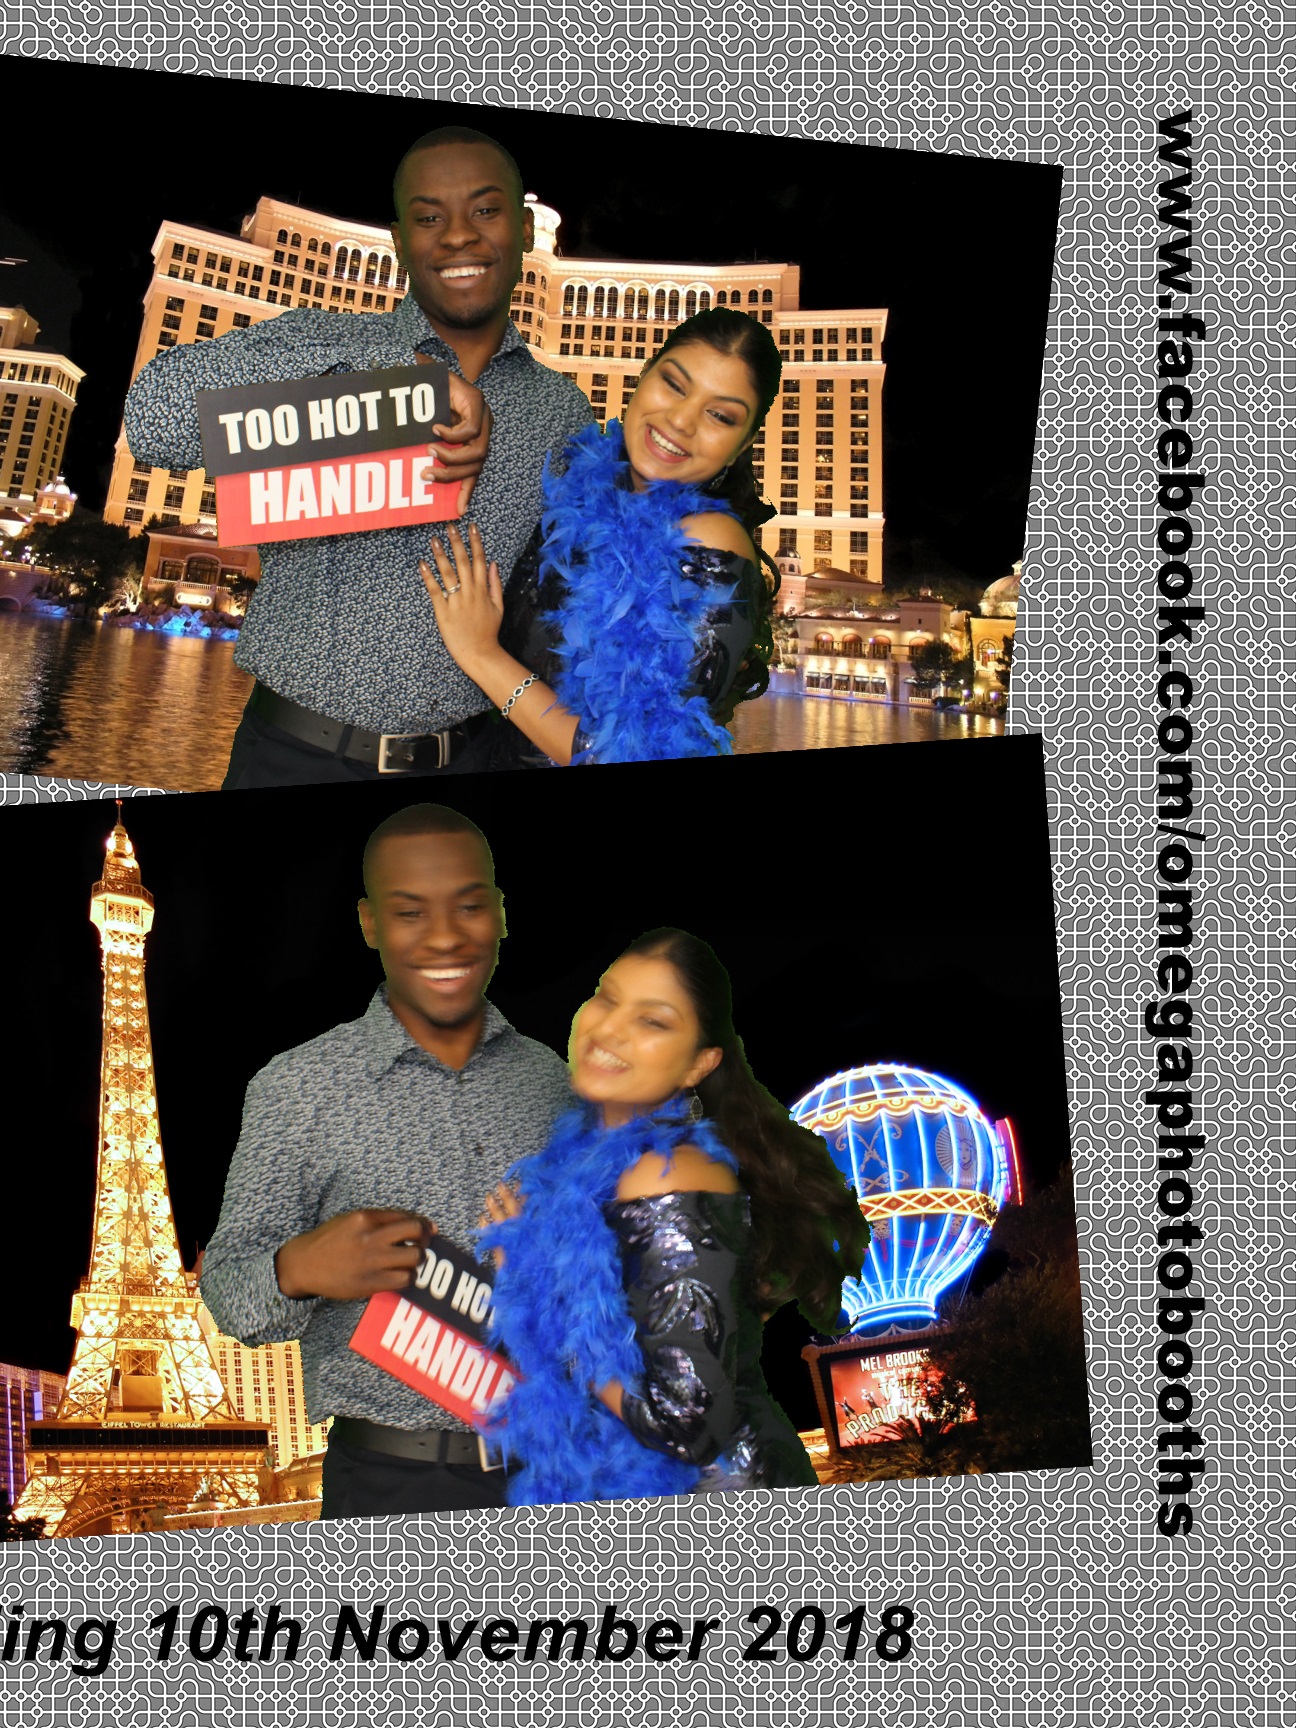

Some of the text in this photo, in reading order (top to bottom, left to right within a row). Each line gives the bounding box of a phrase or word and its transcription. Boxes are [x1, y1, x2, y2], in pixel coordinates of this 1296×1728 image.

[218, 383, 435, 455] TOO HOT TO
[249, 456, 434, 525] HANDLE
[404, 1241, 497, 1329] OO HO
[859, 1356, 883, 1372] MEL
[101, 1421, 128, 1429] EIFFEL
